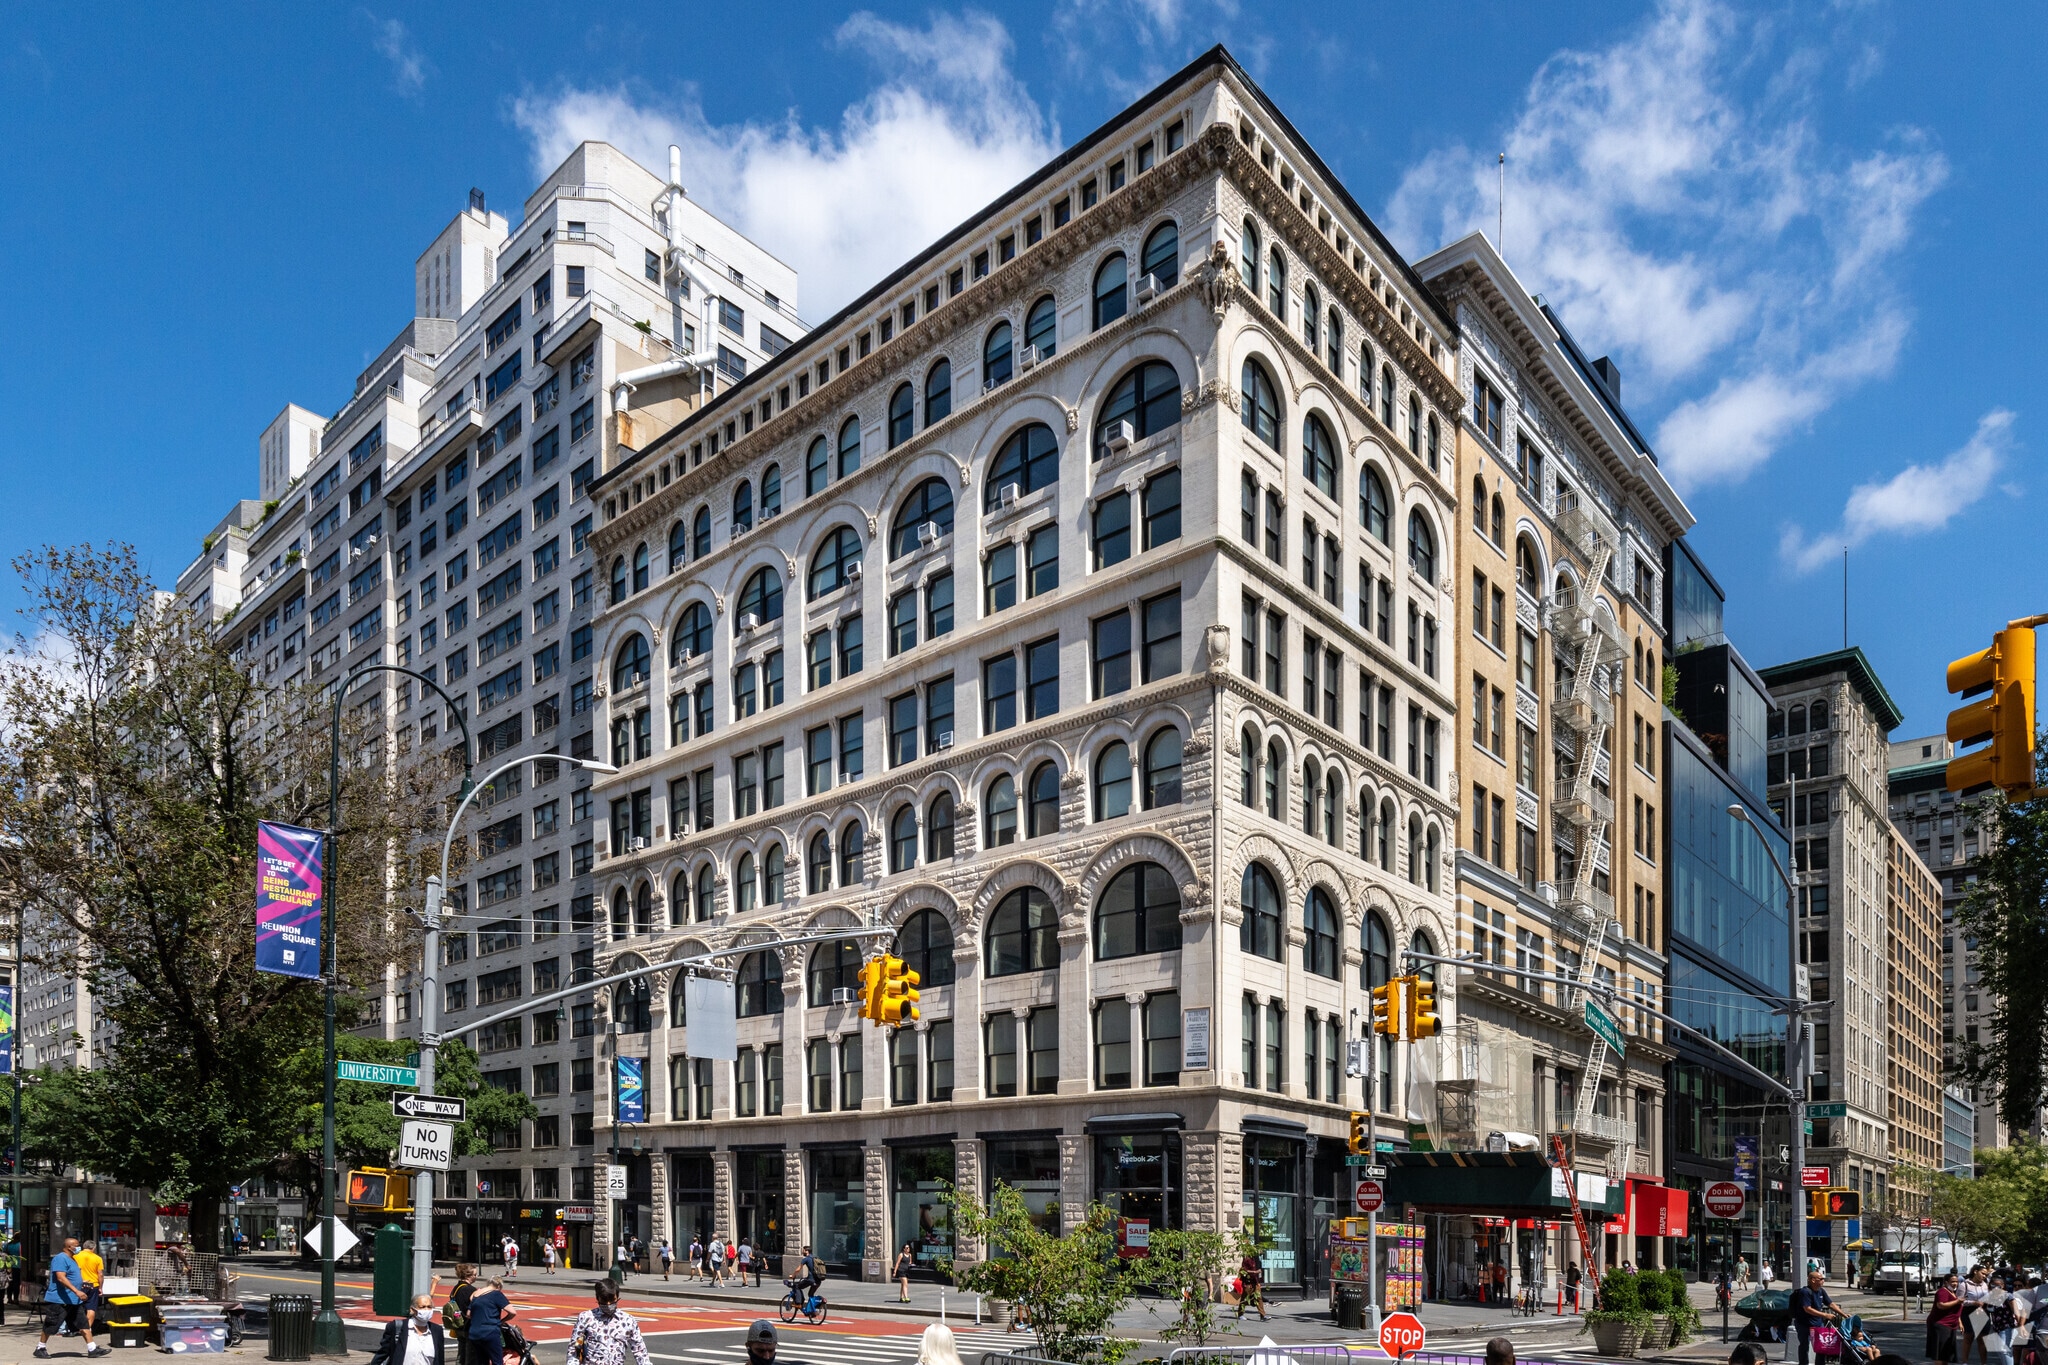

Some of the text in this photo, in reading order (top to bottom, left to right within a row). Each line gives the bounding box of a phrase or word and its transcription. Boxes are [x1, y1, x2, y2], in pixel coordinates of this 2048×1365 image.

[263, 857, 296, 868] LET'S GET
[270, 865, 289, 873] BACK
[263, 876, 289, 886] BEING
[263, 884, 317, 900] RESTAURANT
[269, 892, 313, 907] REGULARS
[262, 922, 300, 934] REUNION
[282, 933, 316, 946] SQUARE
[341, 1064, 402, 1082] UNIVERSITY
[405, 1101, 456, 1113] ONE WAY
[1810, 1107, 1815, 1116] E
[1820, 1106, 1830, 1116] 14
[417, 1128, 438, 1142] NO
[404, 1145, 448, 1162] TURNS
[610, 1178, 624, 1188] 25
[1383, 1327, 1422, 1345] STOP
